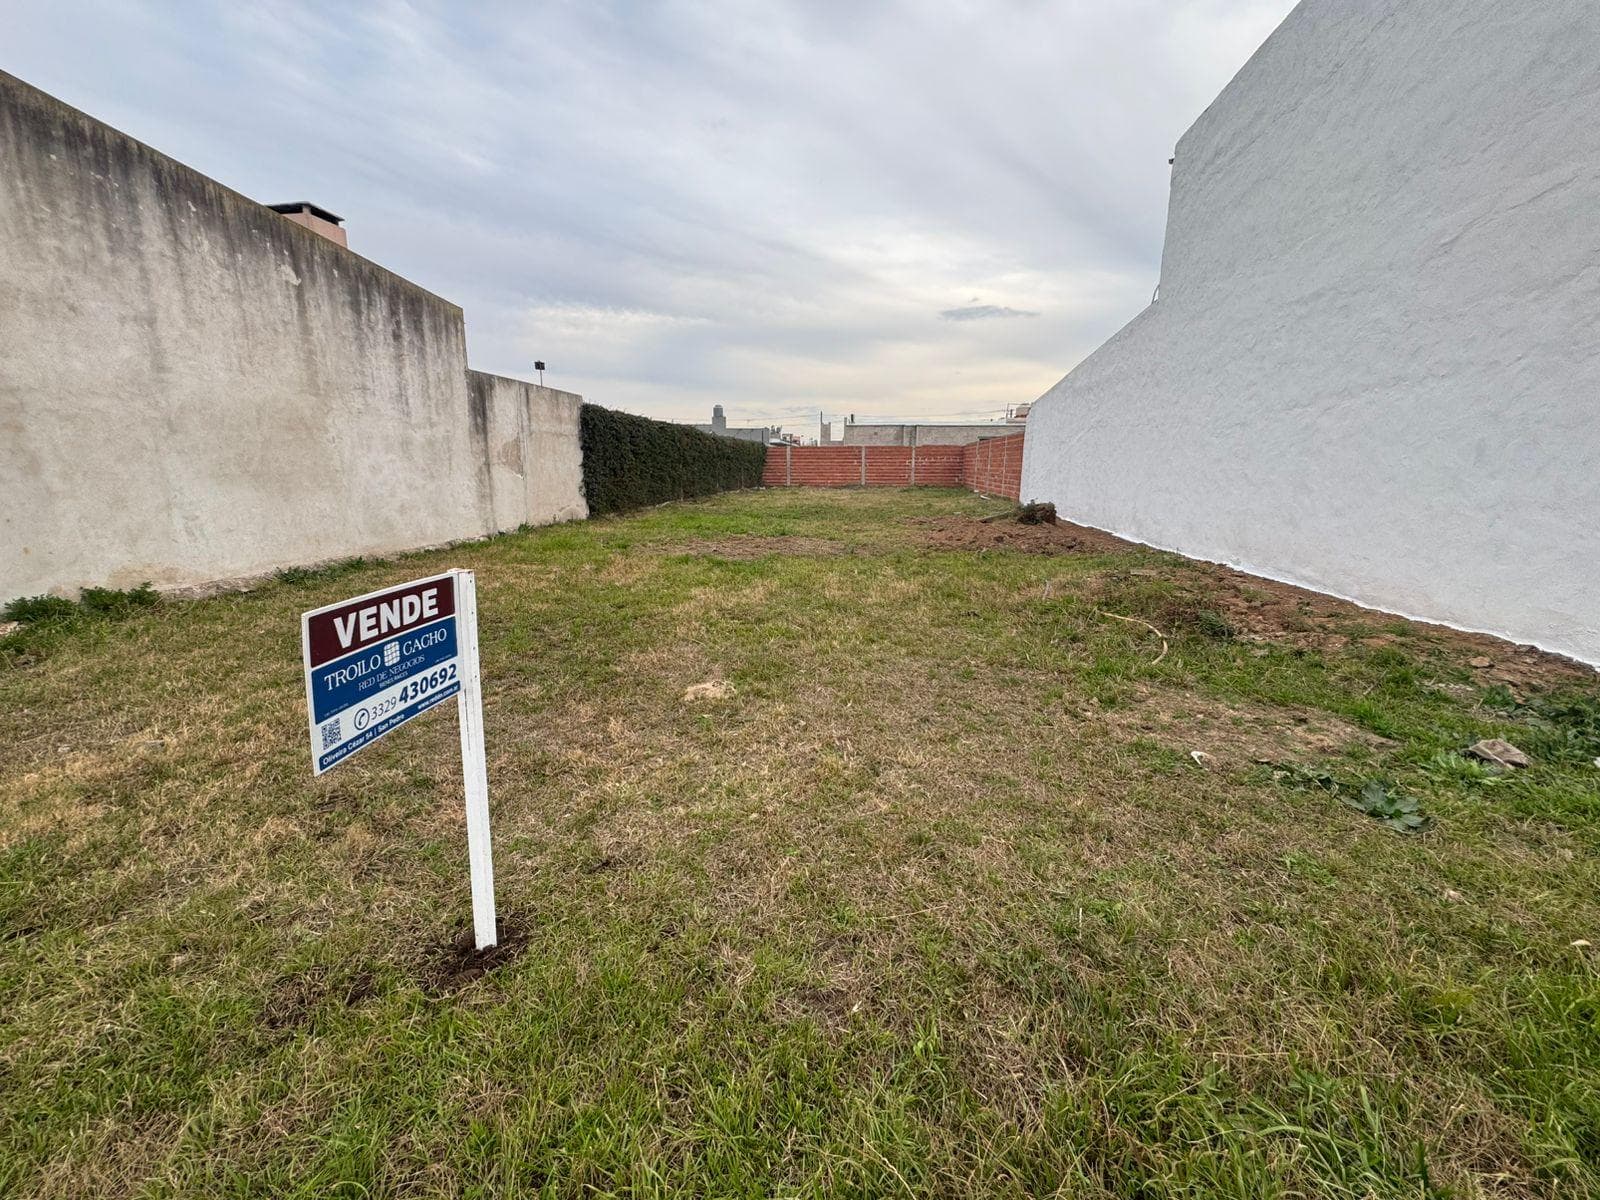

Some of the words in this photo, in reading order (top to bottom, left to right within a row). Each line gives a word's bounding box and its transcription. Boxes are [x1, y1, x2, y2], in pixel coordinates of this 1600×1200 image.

[333, 588, 439, 649] VENDE
[324, 654, 381, 691] TROILO
[403, 628, 447, 656] CACHO
[358, 677, 375, 691] RED
[376, 671, 388, 682] DE
[389, 655, 425, 676] NEGOCIOS
[371, 697, 397, 720] 3329
[399, 663, 457, 703] 430692
[323, 747, 347, 765] Oliveira
[378, 723, 389, 732] San
[389, 714, 405, 726] Pedro
